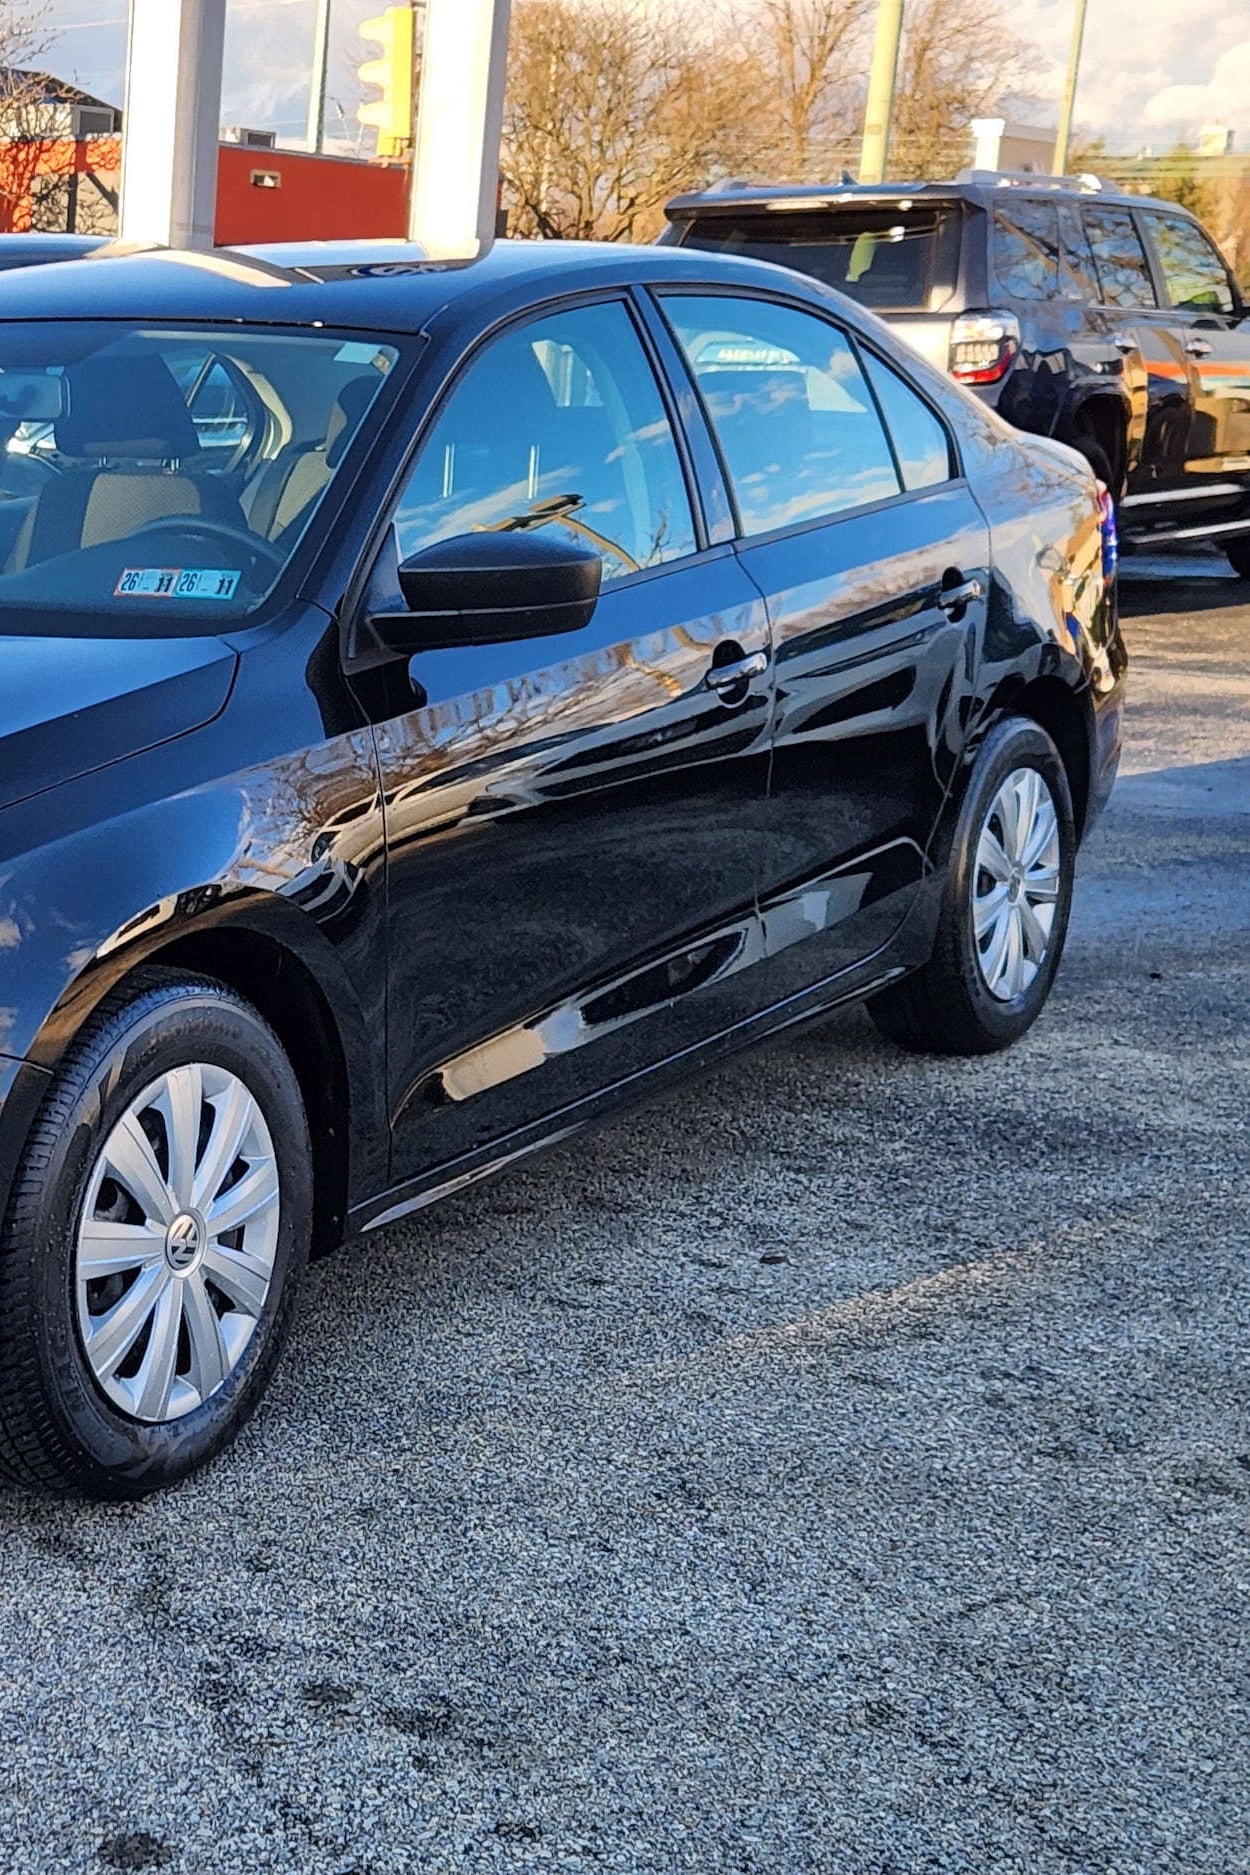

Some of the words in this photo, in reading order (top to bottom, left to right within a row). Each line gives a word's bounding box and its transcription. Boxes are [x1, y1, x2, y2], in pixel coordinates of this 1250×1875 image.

[120, 572, 140, 591] 26
[155, 576, 174, 593] 11
[179, 573, 198, 592] 26
[215, 578, 235, 595] 11
